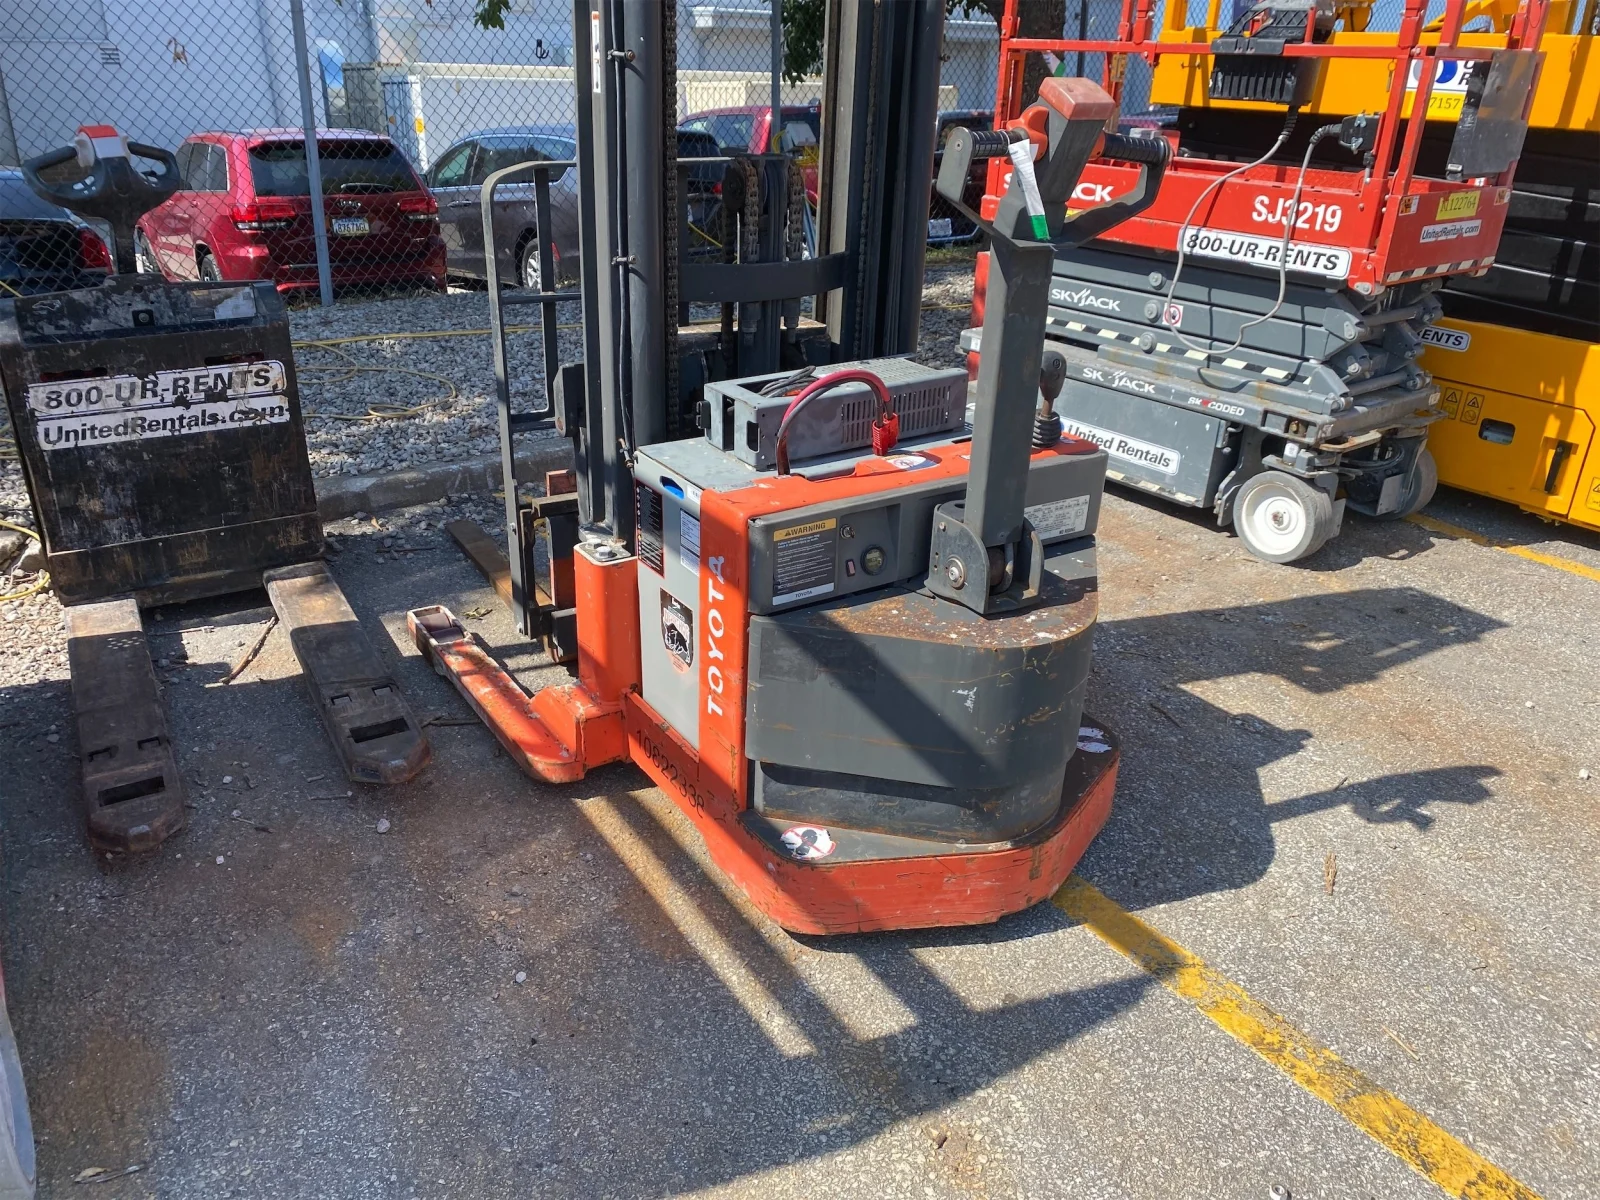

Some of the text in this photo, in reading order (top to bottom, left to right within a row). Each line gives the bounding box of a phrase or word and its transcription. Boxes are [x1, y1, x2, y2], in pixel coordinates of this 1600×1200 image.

[1251, 194, 1342, 233] SJ3219
[1186, 233, 1340, 271] 800-UR-RENTS
[1051, 287, 1121, 312] SKYJACK
[1417, 329, 1464, 347] ENTS
[44, 368, 271, 410] 800-UR-RENTS
[43, 405, 284, 445] UnitedRentals.com
[1116, 439, 1171, 468] Rentals
[790, 522, 826, 535] WARNING
[708, 555, 725, 717] TOYOTA
